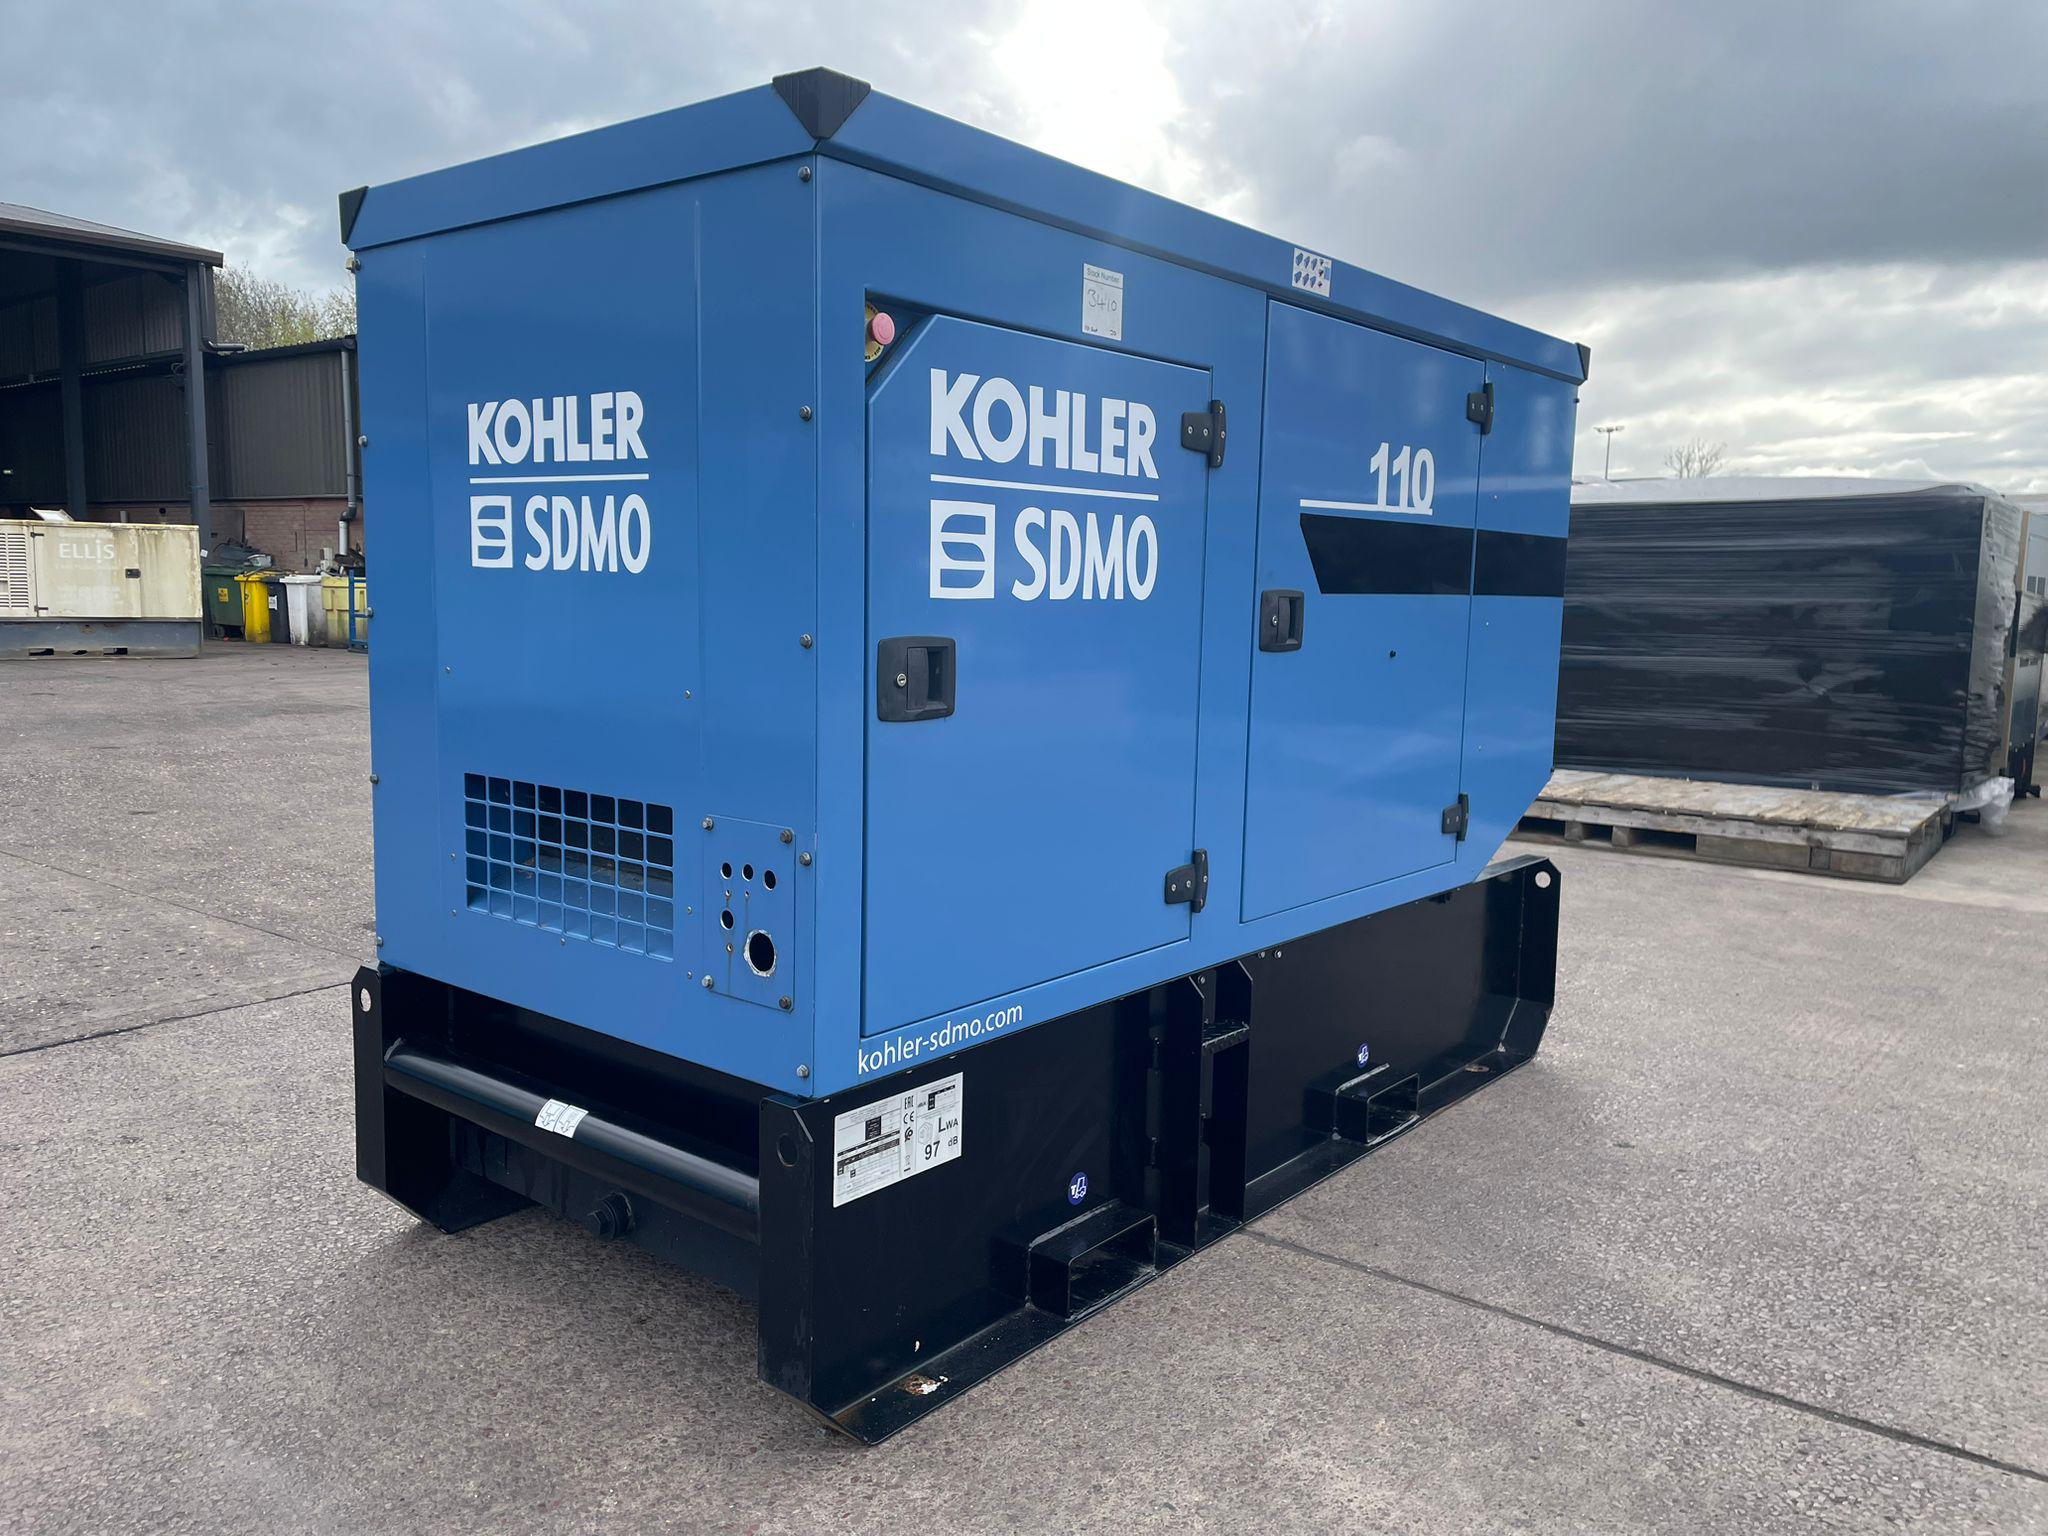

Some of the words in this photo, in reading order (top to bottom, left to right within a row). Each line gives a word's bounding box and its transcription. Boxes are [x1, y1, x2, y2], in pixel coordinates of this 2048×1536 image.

[467, 391, 649, 465] KOHLER
[930, 367, 1160, 479] KOHLER
[1370, 442, 1435, 513] 110
[523, 493, 651, 574] SDMO
[1011, 506, 1158, 601] SDMO
[858, 1004, 1024, 1075] kohler-sdmo.com
[924, 1140, 941, 1161] 97
[947, 1135, 959, 1147] dB
